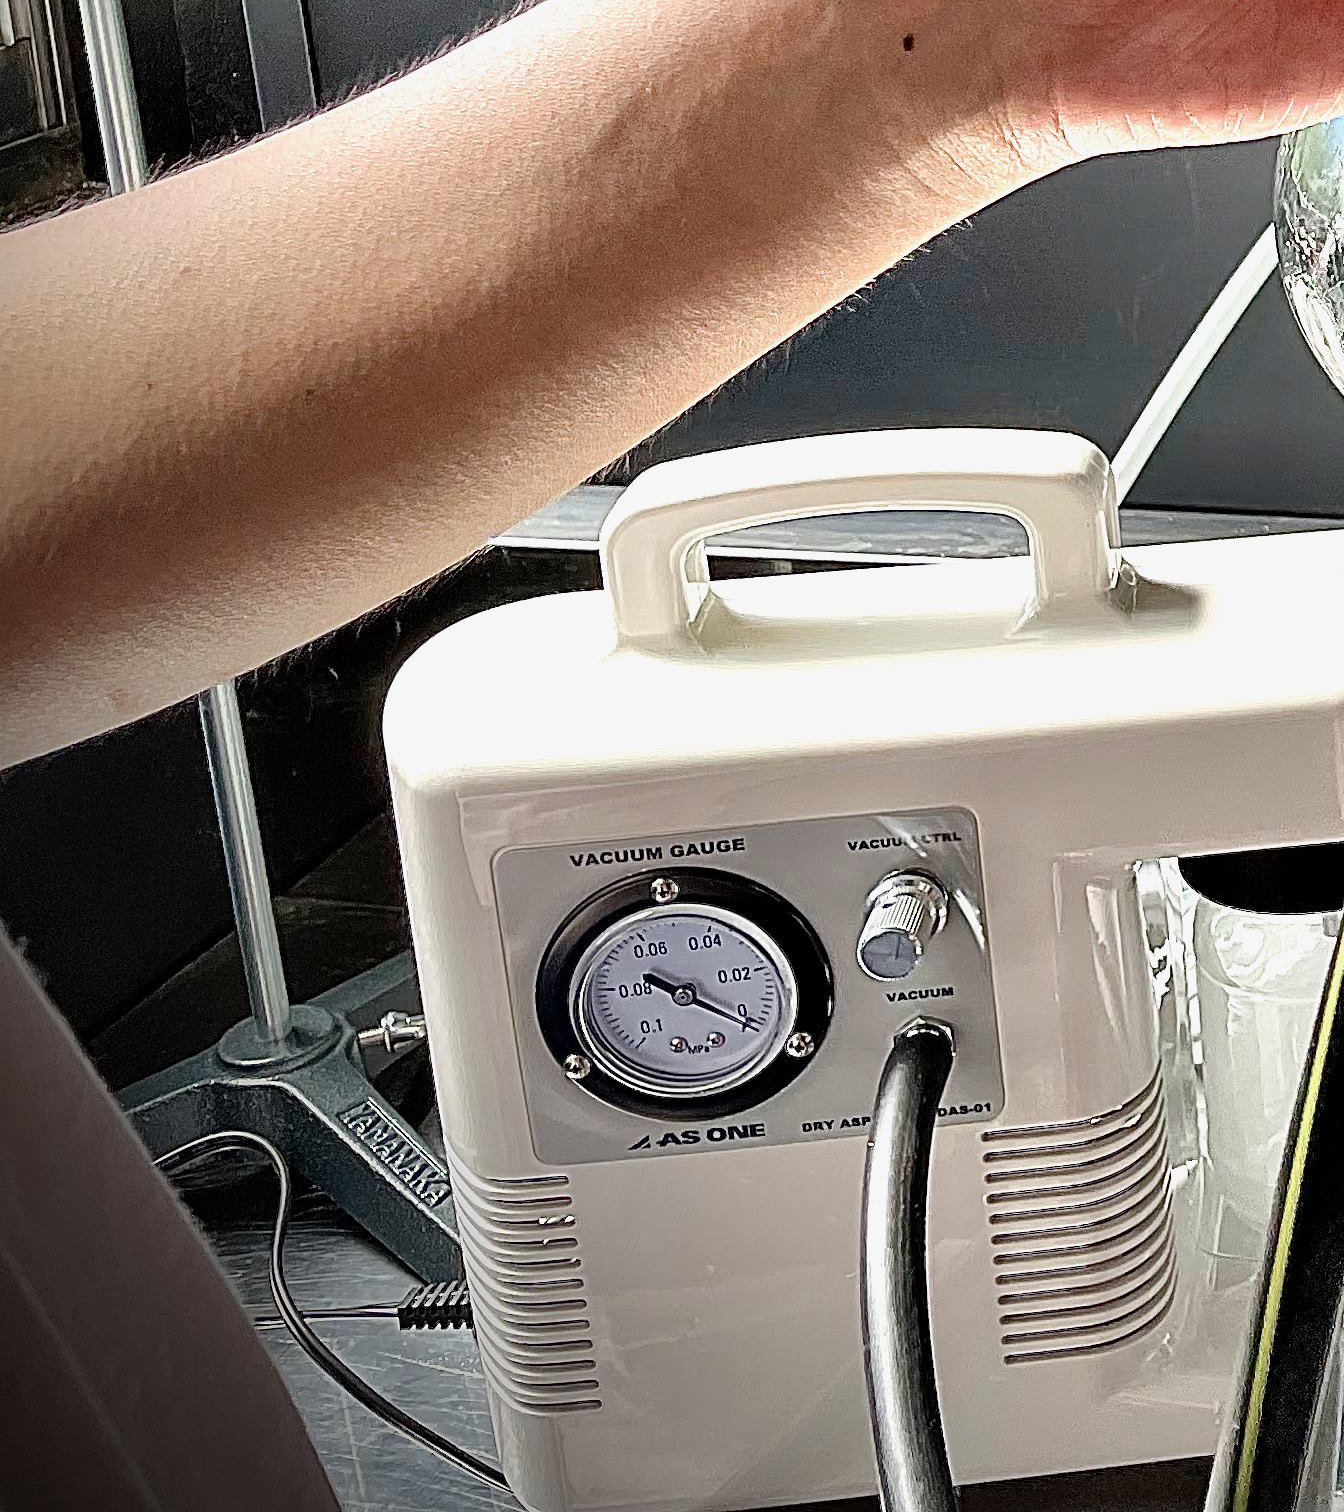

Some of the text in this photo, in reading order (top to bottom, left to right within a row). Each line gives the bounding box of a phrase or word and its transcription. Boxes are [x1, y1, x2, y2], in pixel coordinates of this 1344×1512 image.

[569, 838, 746, 867] VACUUM GAUGE
[633, 941, 668, 959] 0.06
[688, 934, 722, 951] 0.04
[717, 966, 752, 984] 0.02
[618, 982, 653, 999] 0.08
[886, 987, 954, 1002] VACUUM
[737, 1003, 748, 1017] 0
[640, 1018, 664, 1035] 0.1
[706, 1122, 766, 1142] ONE
[802, 1119, 834, 1133] DRY
